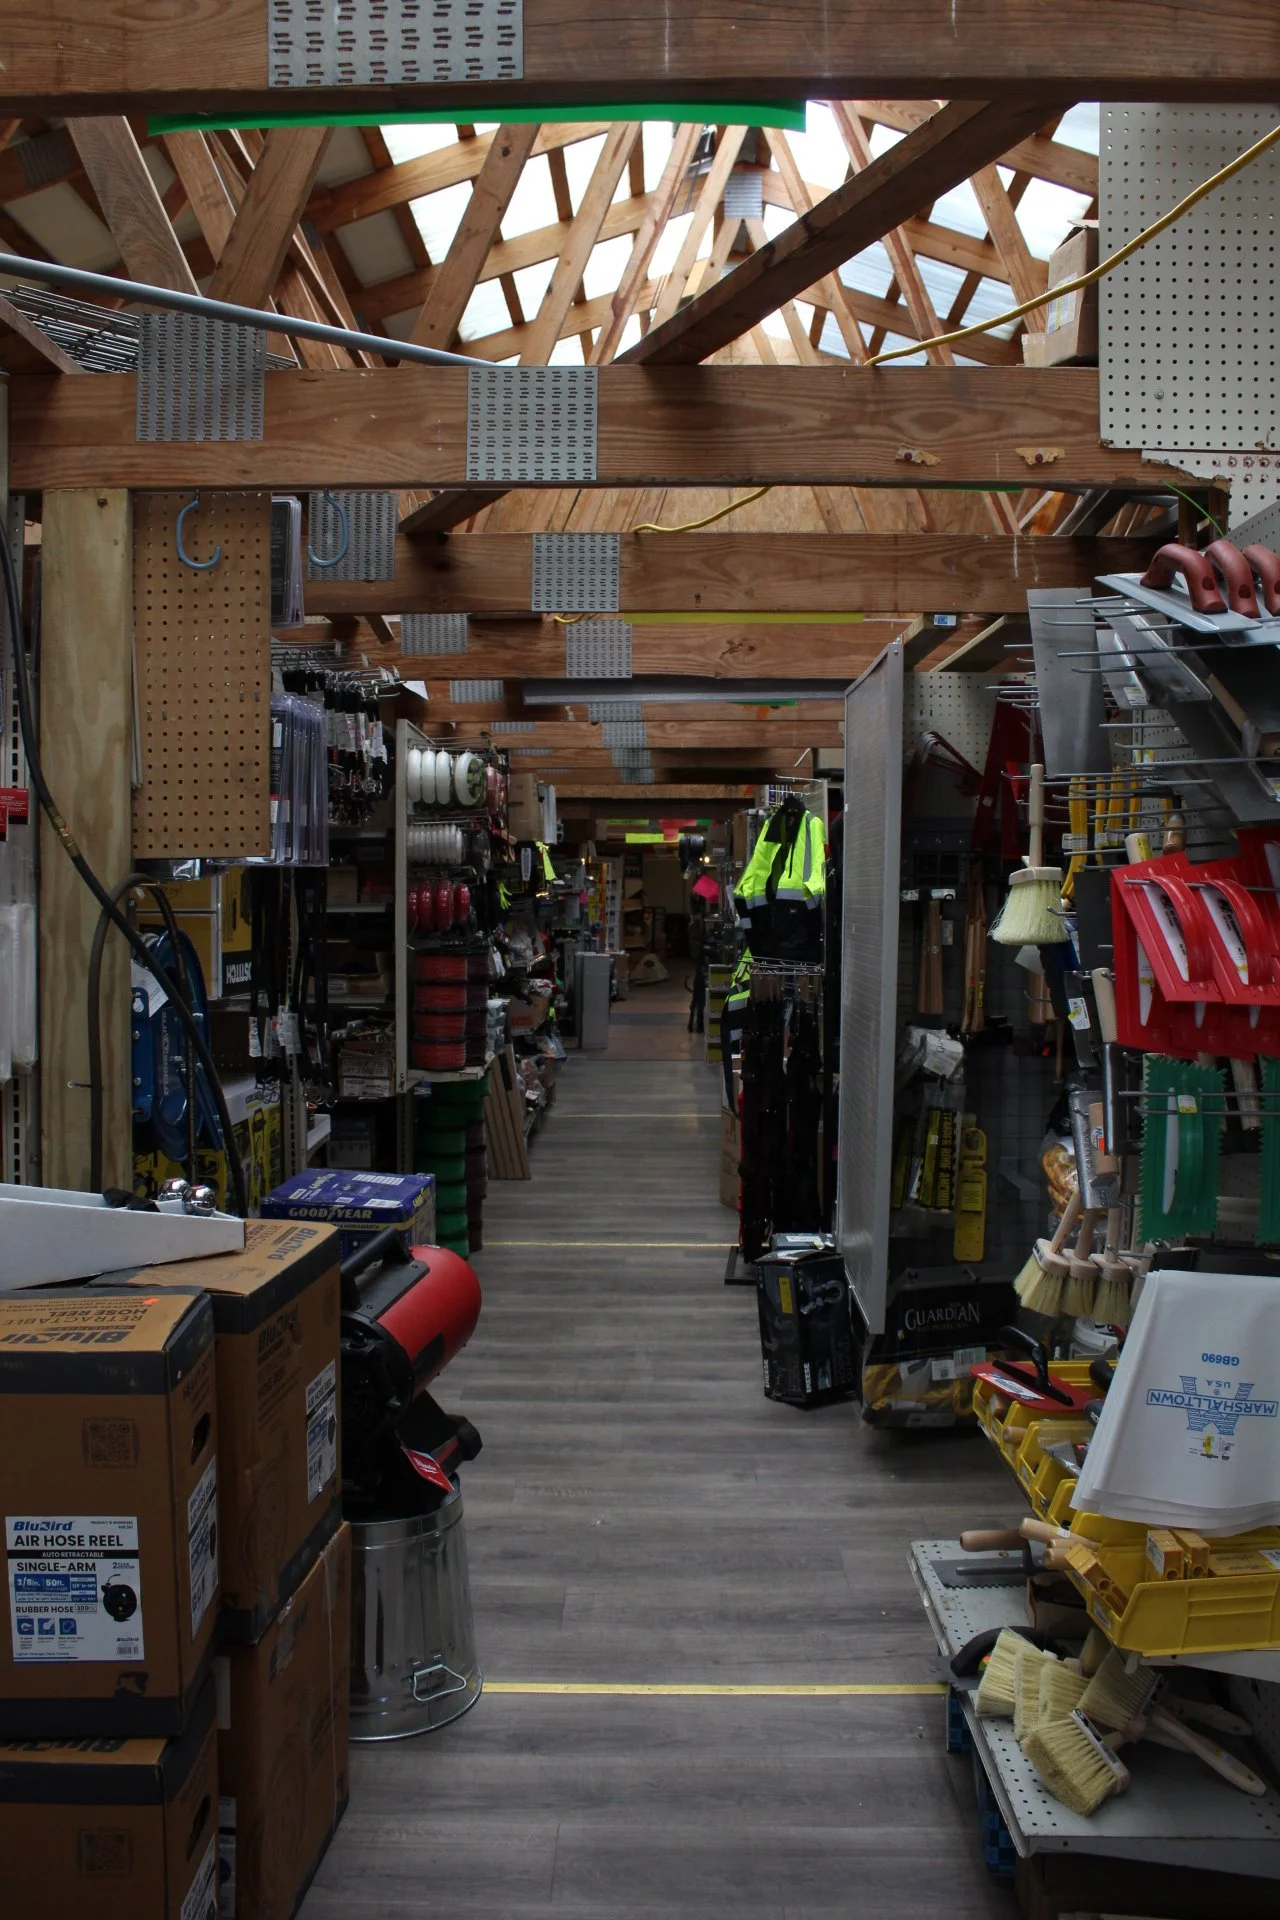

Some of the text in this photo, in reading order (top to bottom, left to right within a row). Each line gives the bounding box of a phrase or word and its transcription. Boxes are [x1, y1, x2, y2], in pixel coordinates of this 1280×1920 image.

[288, 1205, 373, 1220] GOODYEAR
[48, 1308, 149, 1318] HOSE REEL
[904, 1300, 981, 1331] GUARDIAN
[2, 1314, 143, 1326] RETRACTABLE
[1201, 1352, 1240, 1367] GB690
[1150, 1391, 1275, 1414] MARSHALLTOWN
[13, 1521, 73, 1531] BluBird
[14, 1535, 124, 1547] AIR HOSE REEL
[17, 1562, 96, 1572] SINGLE-ARM
[16, 1605, 74, 1614] RUBBER HOSE
